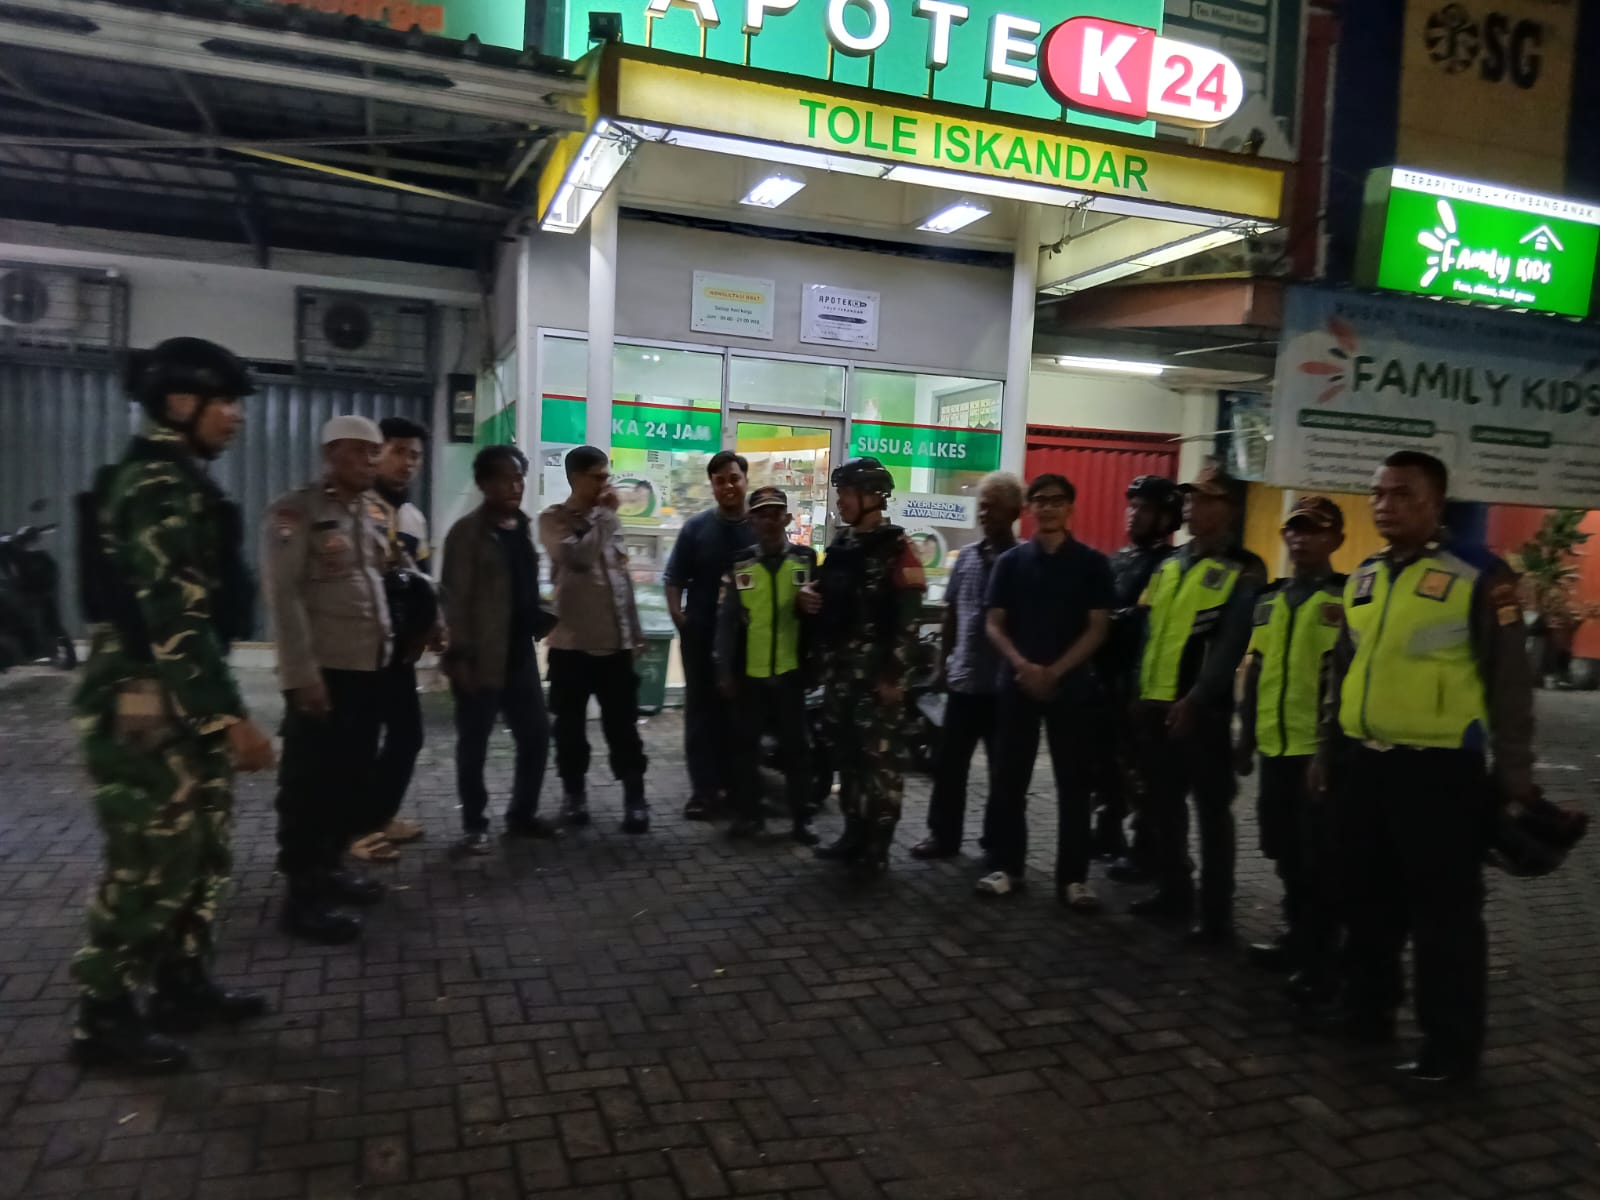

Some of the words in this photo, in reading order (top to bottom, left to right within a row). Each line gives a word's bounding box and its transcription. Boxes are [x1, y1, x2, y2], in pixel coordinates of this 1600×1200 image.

[1079, 27, 1139, 104] K
[1161, 54, 1228, 113] 24
[799, 98, 917, 156] TOLE
[932, 122, 1149, 193] ISKANDAR
[1351, 355, 1510, 407] FAMILY
[1520, 377, 1600, 417] KIDS
[645, 421, 667, 439] 24
[672, 423, 712, 442] JAM
[857, 436, 901, 455] SUSU
[902, 443, 914, 456] &
[917, 442, 967, 459] ALKES
